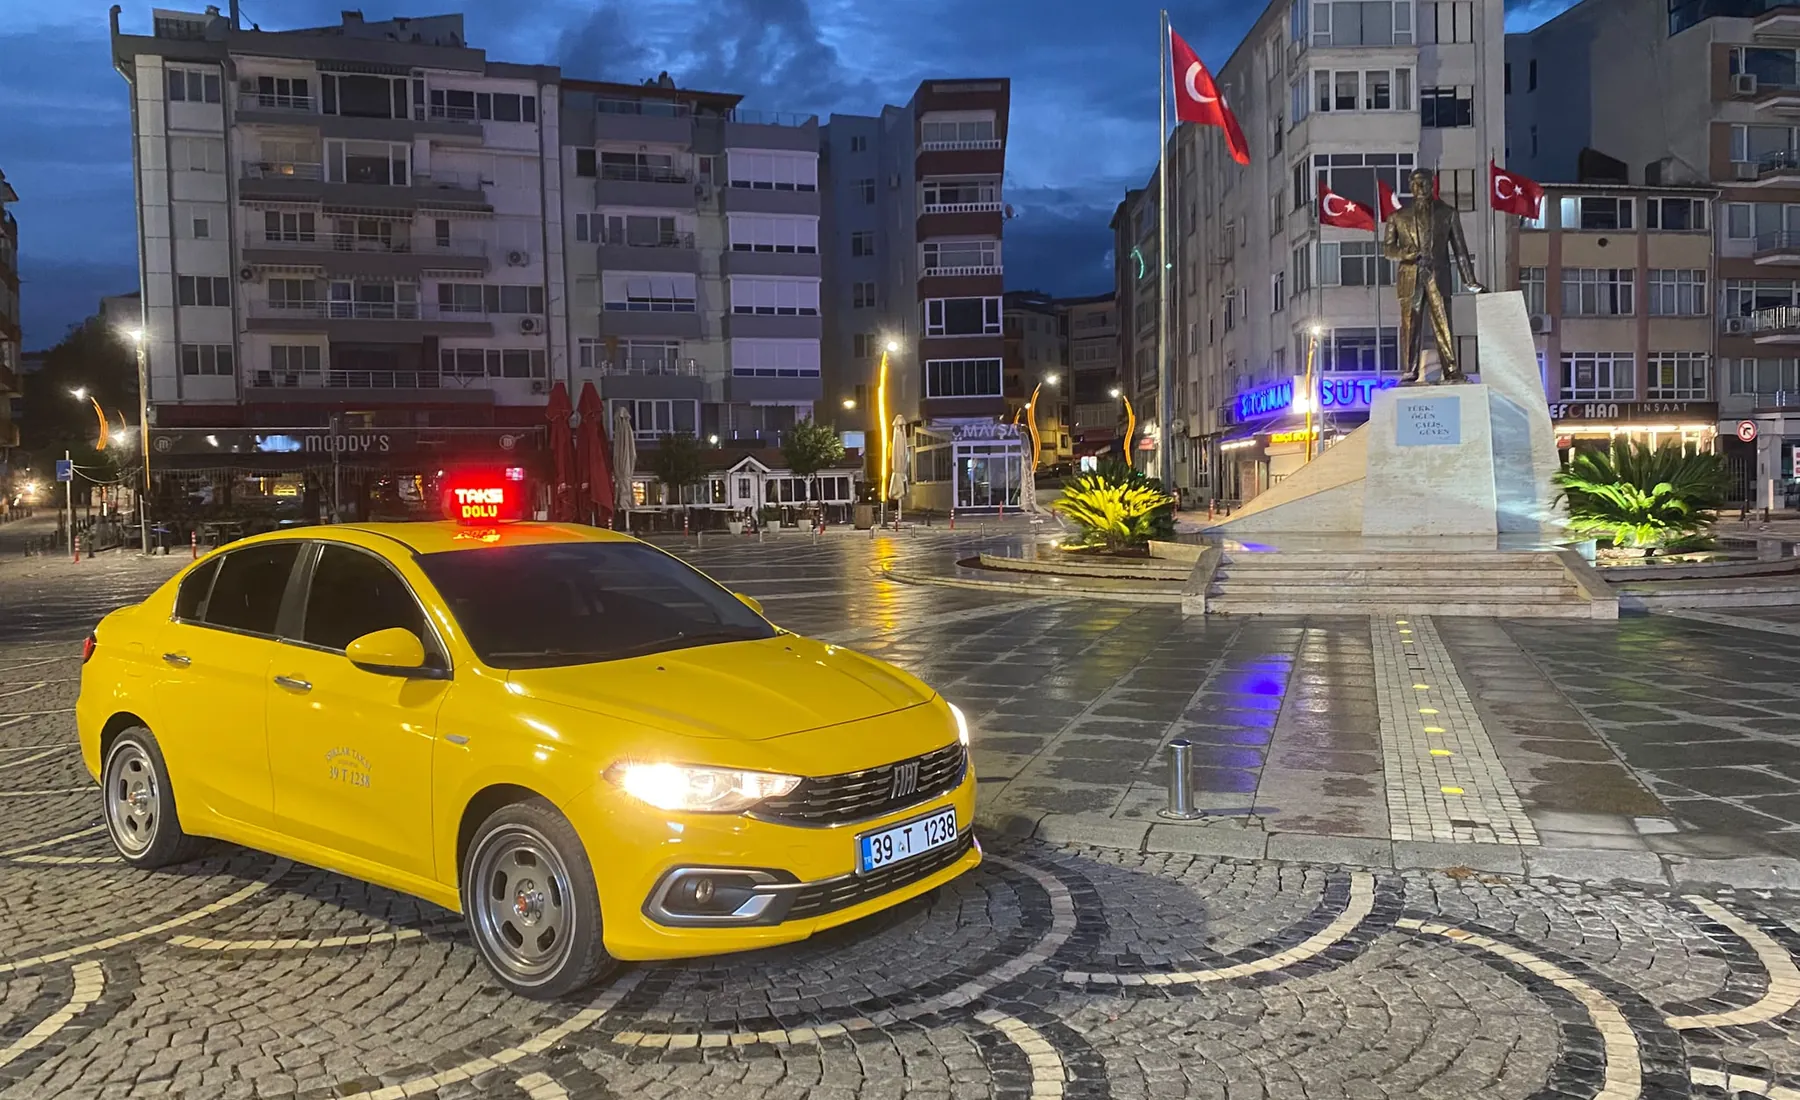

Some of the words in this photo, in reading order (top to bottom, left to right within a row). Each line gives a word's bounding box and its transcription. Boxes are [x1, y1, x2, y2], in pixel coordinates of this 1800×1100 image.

[1322, 380, 1397, 404] SÜT
[305, 434, 389, 452] MOODY'S
[462, 505, 498, 518] DOLU
[329, 765, 340, 781] 39
[341, 768, 348, 783] T
[350, 771, 371, 788] 1238
[890, 761, 920, 799] FIAT
[872, 834, 893, 864] 39
[903, 827, 913, 853] T
[924, 813, 956, 847] 1238
